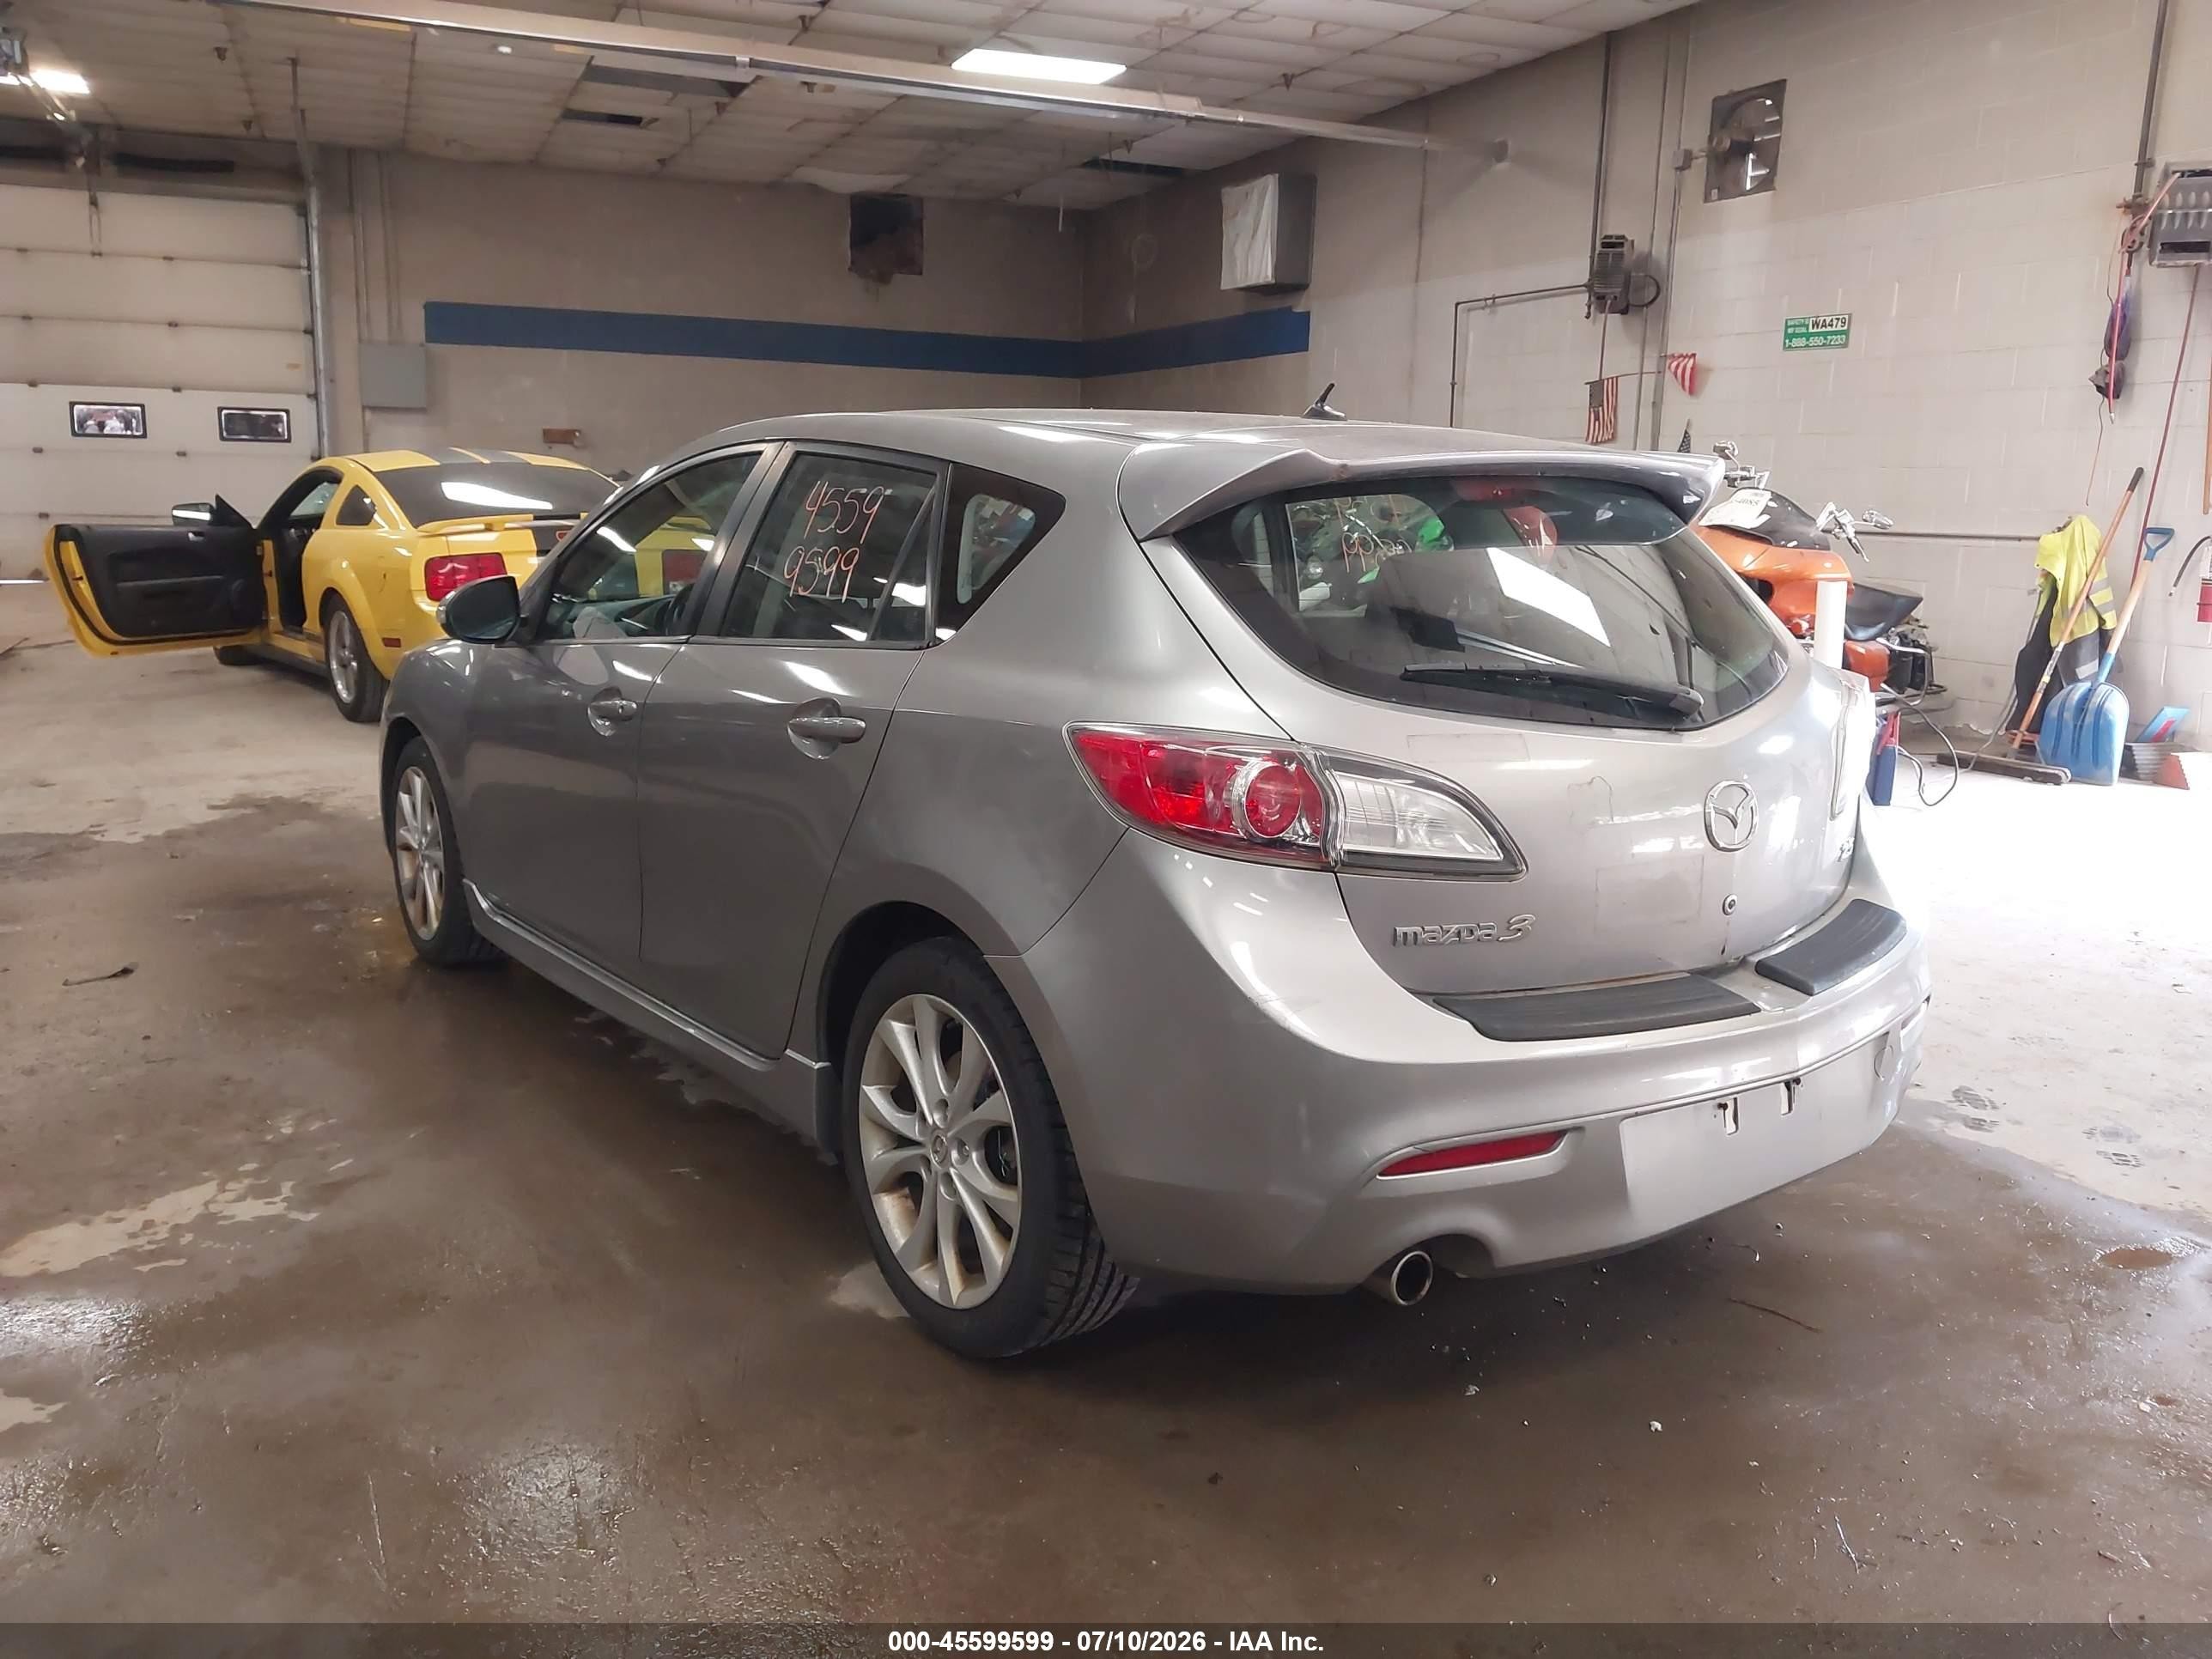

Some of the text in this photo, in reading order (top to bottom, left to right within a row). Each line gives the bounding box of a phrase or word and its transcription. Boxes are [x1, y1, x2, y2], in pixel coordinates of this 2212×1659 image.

[1811, 317, 1847, 331] WA479
[804, 481, 884, 544] 4559
[784, 545, 860, 604] 9599
